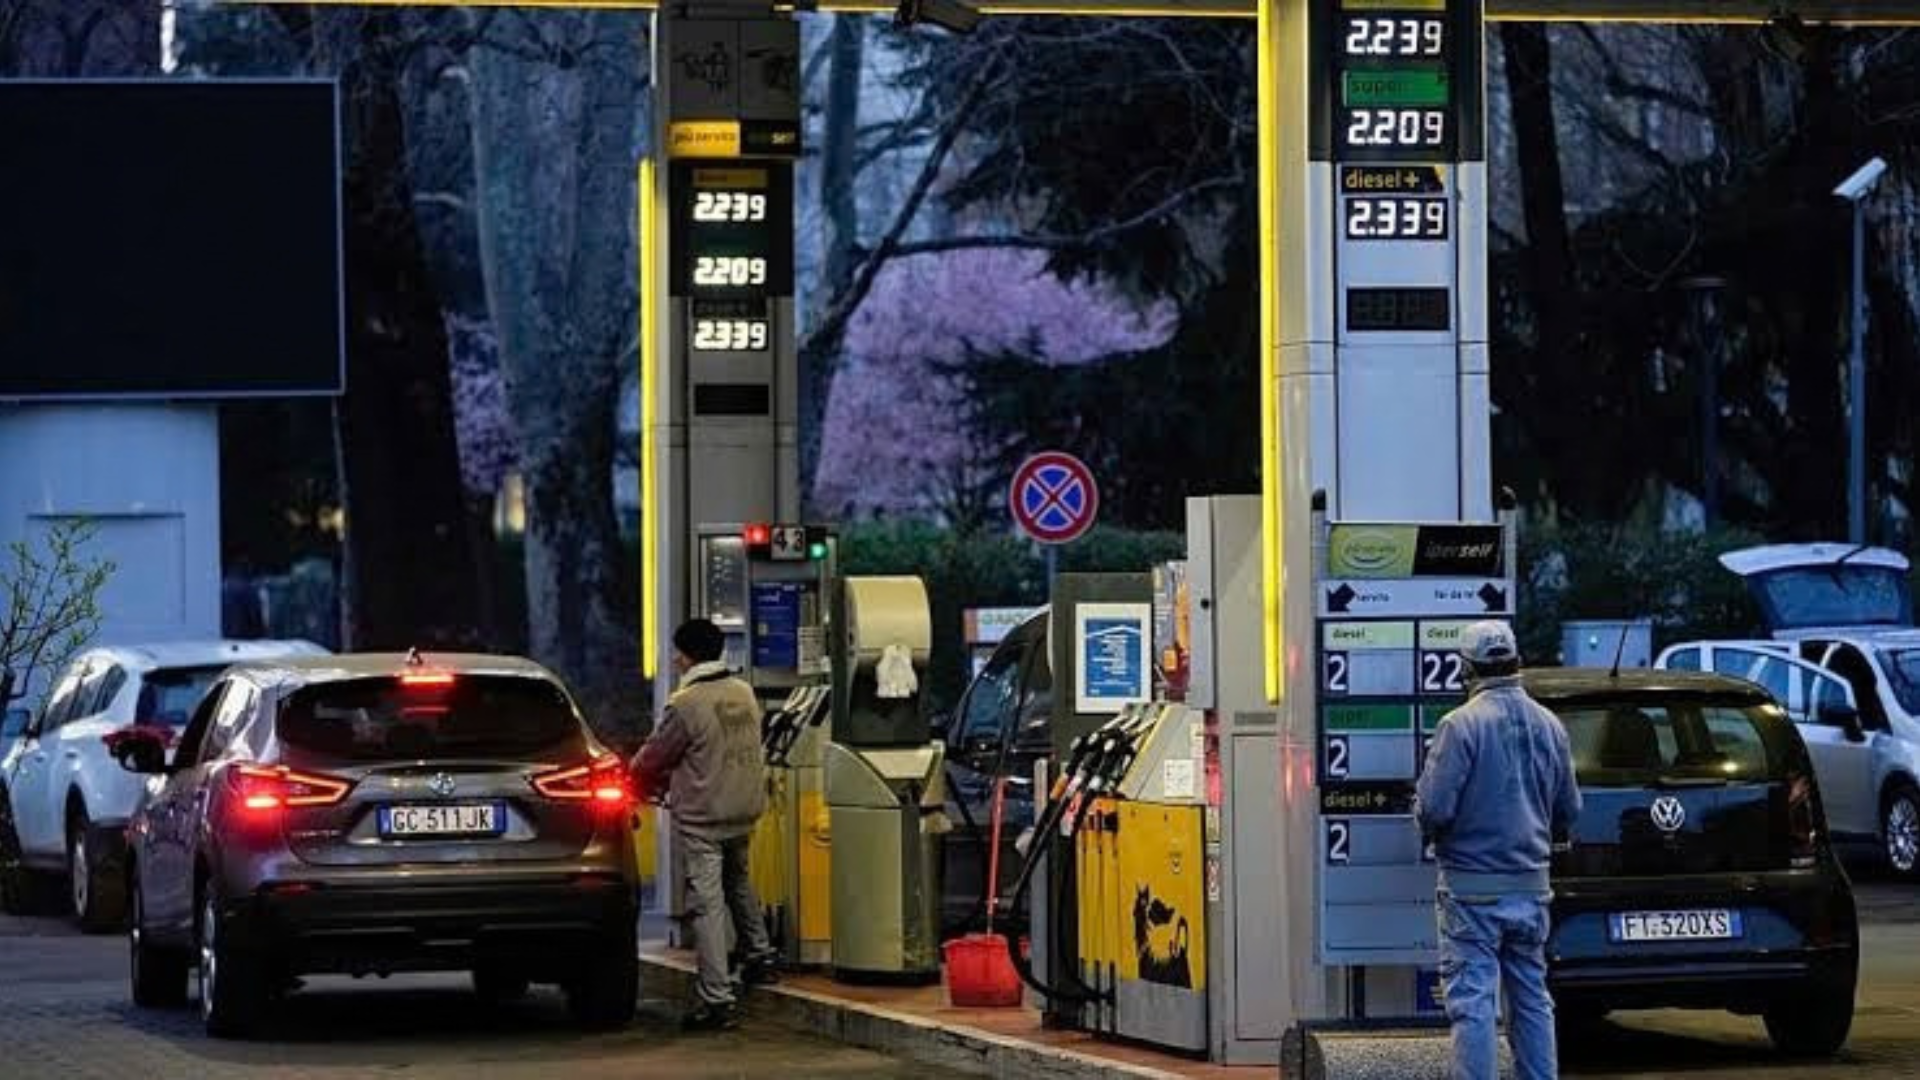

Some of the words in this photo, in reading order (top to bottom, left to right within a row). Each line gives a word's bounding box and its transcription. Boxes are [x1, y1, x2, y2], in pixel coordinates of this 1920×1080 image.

[1346, 20, 1442, 54] 2.239
[1348, 110, 1443, 145] 2.209
[1349, 200, 1444, 236] 2.339
